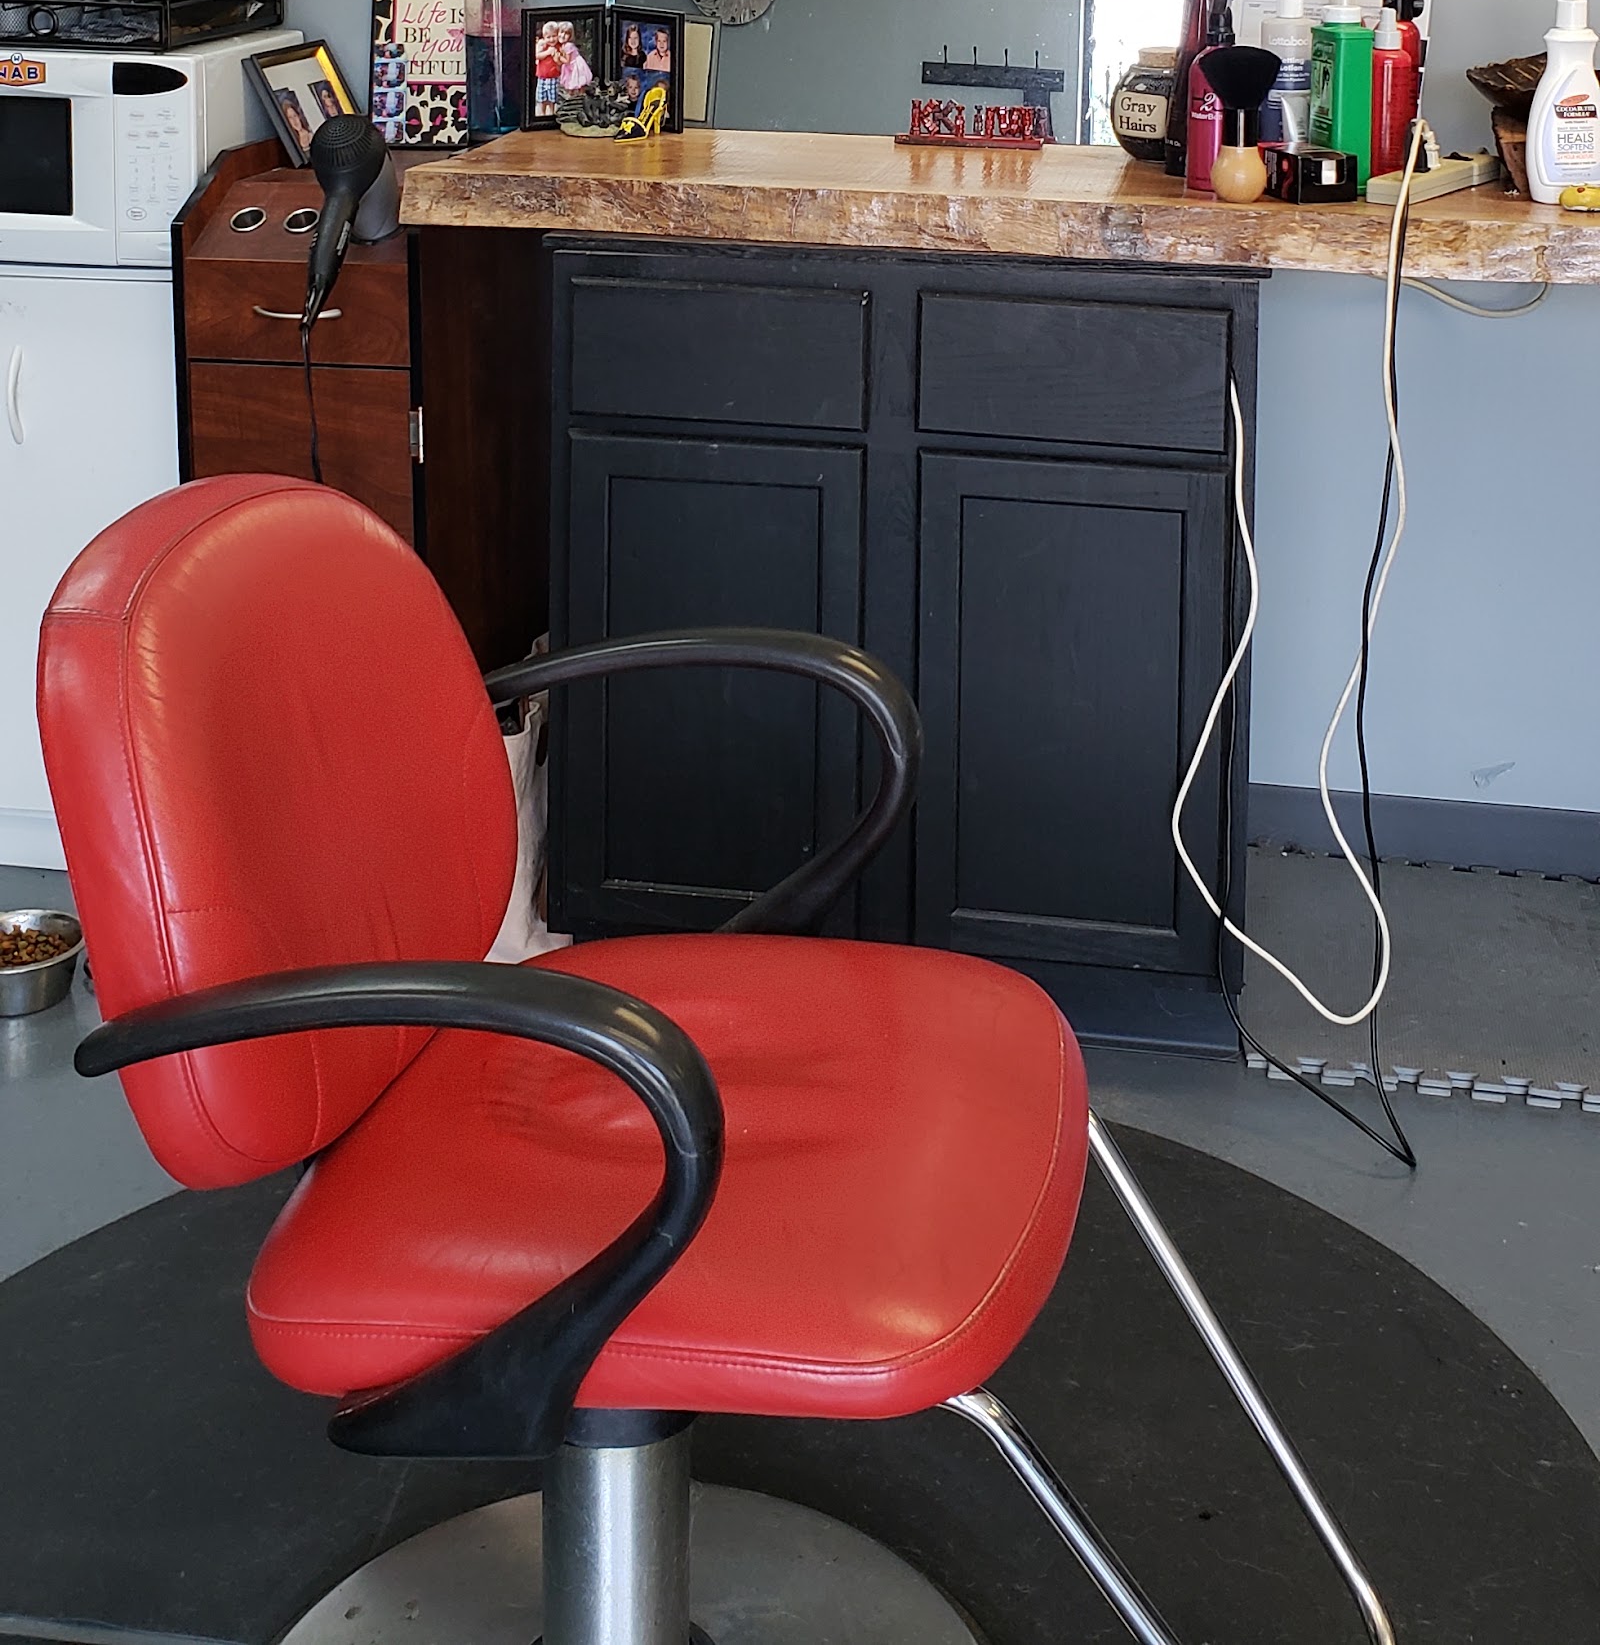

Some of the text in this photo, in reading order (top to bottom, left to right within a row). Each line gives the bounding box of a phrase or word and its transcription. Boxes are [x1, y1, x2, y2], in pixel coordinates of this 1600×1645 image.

[401, 1, 447, 29] Life
[404, 28, 431, 43] BE
[412, 39, 464, 67] you
[1281, 57, 1305, 65] etting
[1120, 96, 1157, 117] Gray
[1119, 116, 1157, 133] Hairs
[1557, 132, 1594, 144] HEALS
[1557, 143, 1594, 152] SOFTENS
